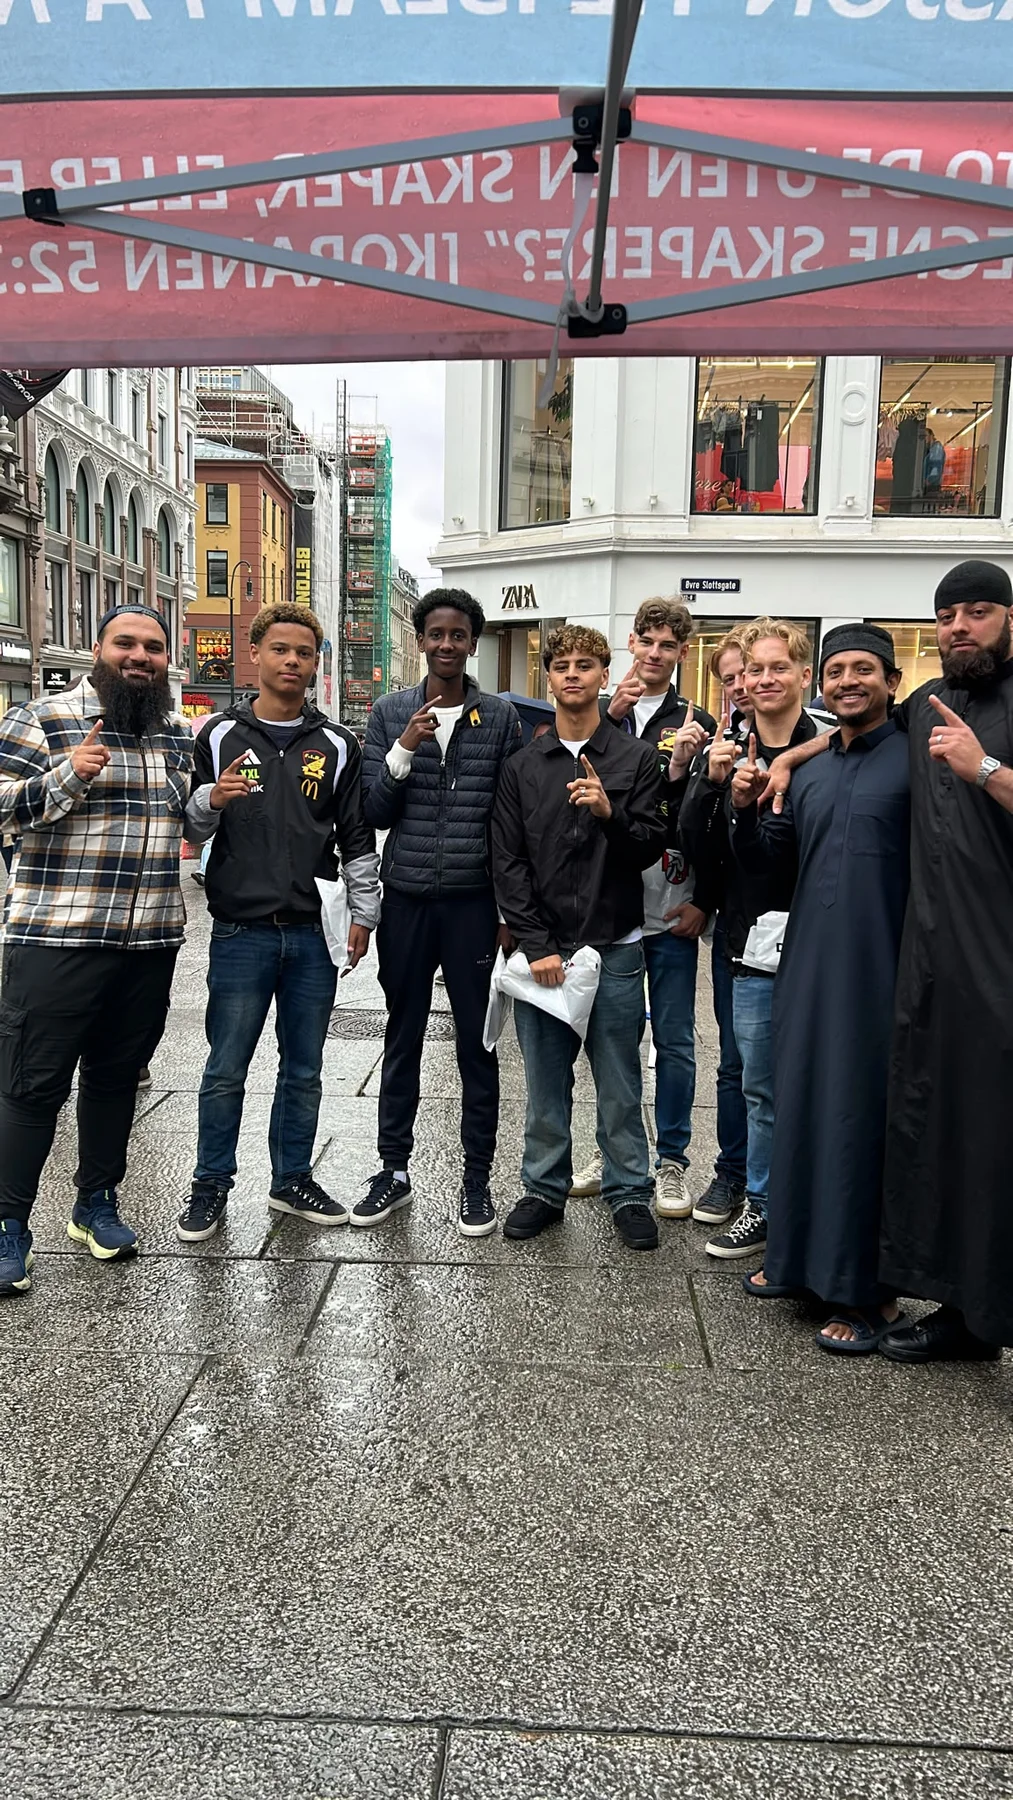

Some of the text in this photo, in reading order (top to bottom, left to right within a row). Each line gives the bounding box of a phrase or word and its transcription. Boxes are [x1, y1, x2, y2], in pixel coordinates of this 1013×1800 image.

[295, 547, 311, 608] BETON
[702, 580, 737, 592] Slottsgate
[501, 583, 540, 610] ZARA
